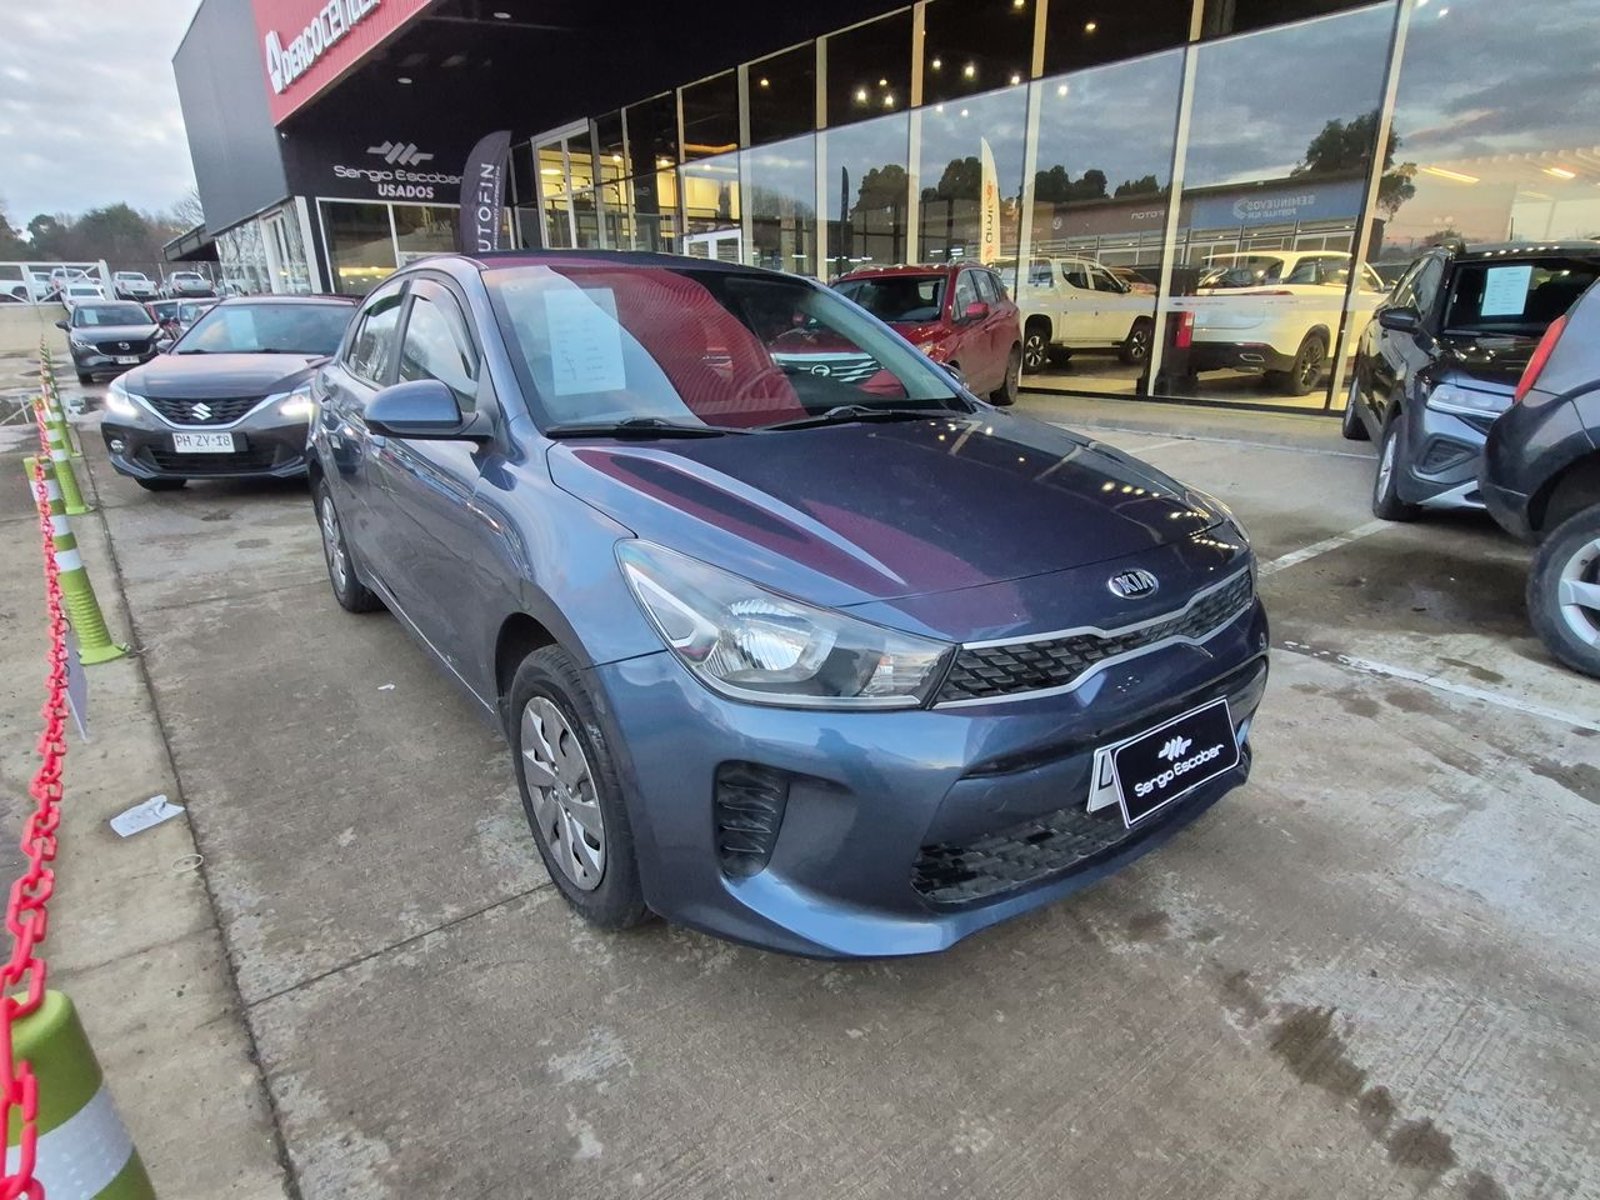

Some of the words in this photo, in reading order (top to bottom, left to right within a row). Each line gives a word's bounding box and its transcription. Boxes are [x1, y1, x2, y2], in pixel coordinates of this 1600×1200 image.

[377, 183, 435, 199] USADOS
[1115, 571, 1154, 594] KIA
[1173, 744, 1224, 776] Escobar
